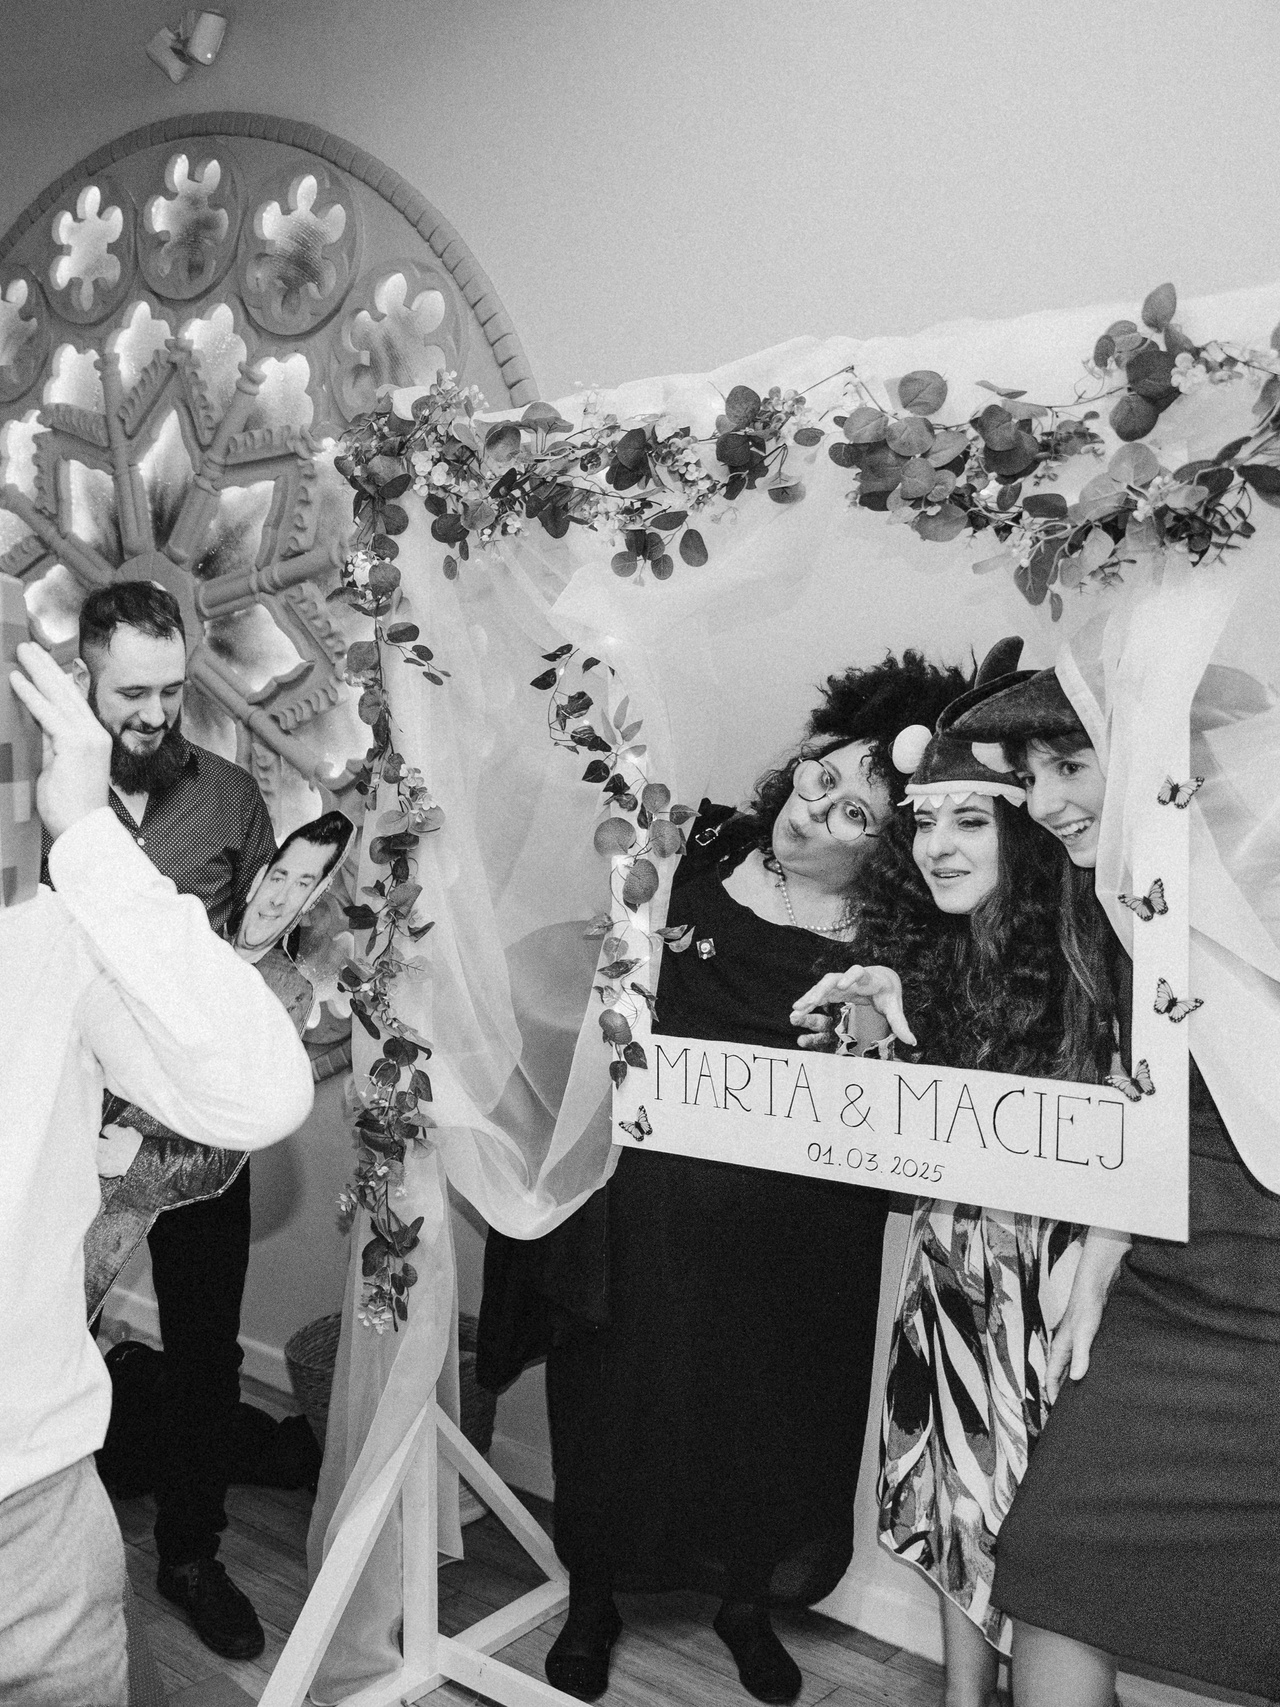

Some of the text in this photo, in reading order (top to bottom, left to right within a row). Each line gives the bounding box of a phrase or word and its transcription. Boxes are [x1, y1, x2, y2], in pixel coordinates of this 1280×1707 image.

[654, 1044, 1125, 1170] MARTA & MACIEJ
[807, 1142, 945, 1183] 01.03.2025
